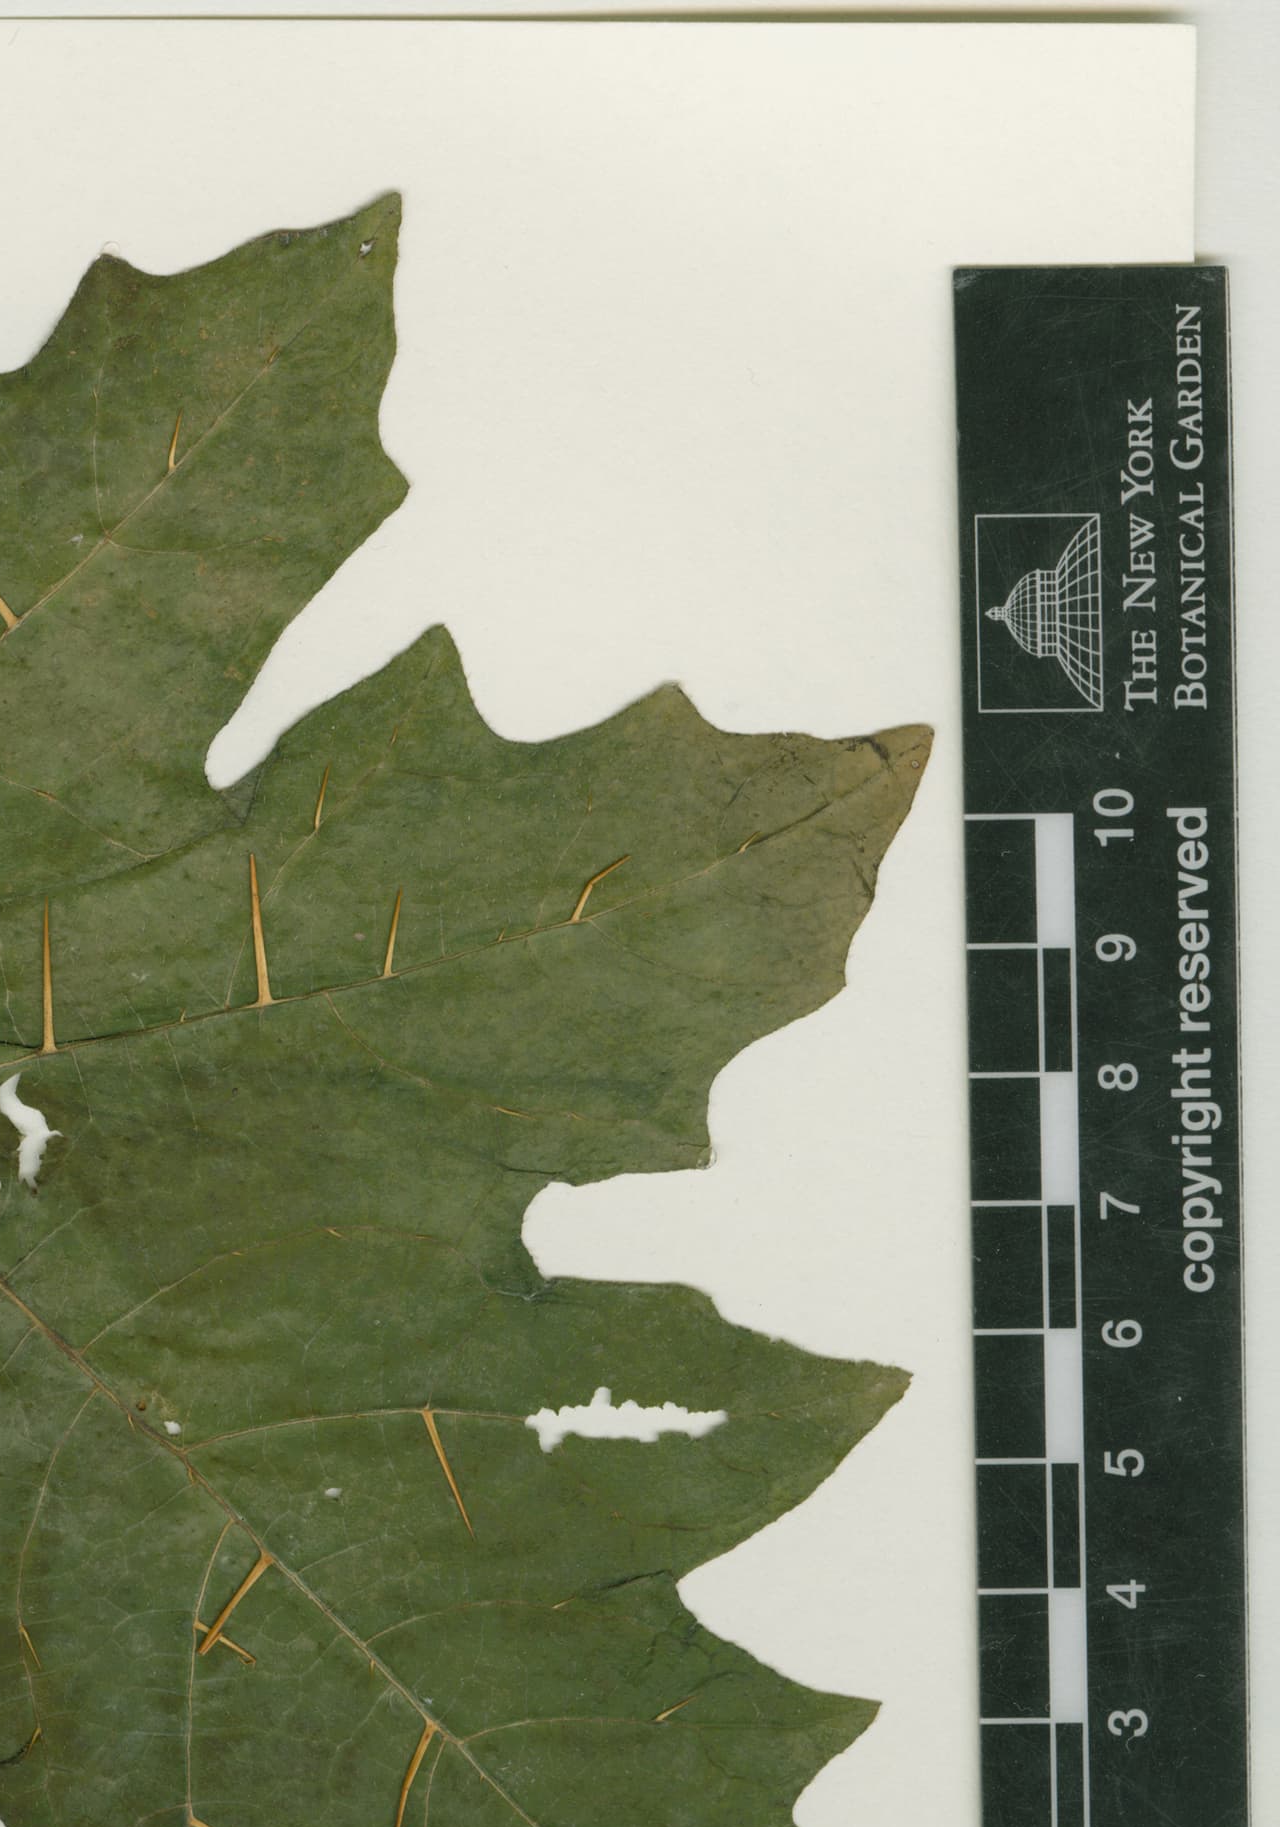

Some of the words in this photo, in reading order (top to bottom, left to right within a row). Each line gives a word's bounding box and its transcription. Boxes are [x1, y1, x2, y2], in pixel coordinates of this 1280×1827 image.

[1170, 304, 1203, 469] GARDEN
[1121, 398, 1153, 504] YORK
[1123, 513, 1156, 611] NEW
[1174, 483, 1207, 709] BOTANICAL
[1124, 630, 1157, 711] THE
[1093, 789, 1133, 846] 10
[1096, 934, 1136, 961] 9
[1167, 808, 1210, 1031] reserved
[1098, 1063, 1138, 1091] 8
[1171, 1048, 1222, 1292] copyright
[1100, 1192, 1139, 1219] 7
[1102, 1320, 1142, 1347] 6
[1104, 1449, 1144, 1476] 5
[1107, 1580, 1145, 1608] 4
[1108, 1709, 1148, 1736] 3
